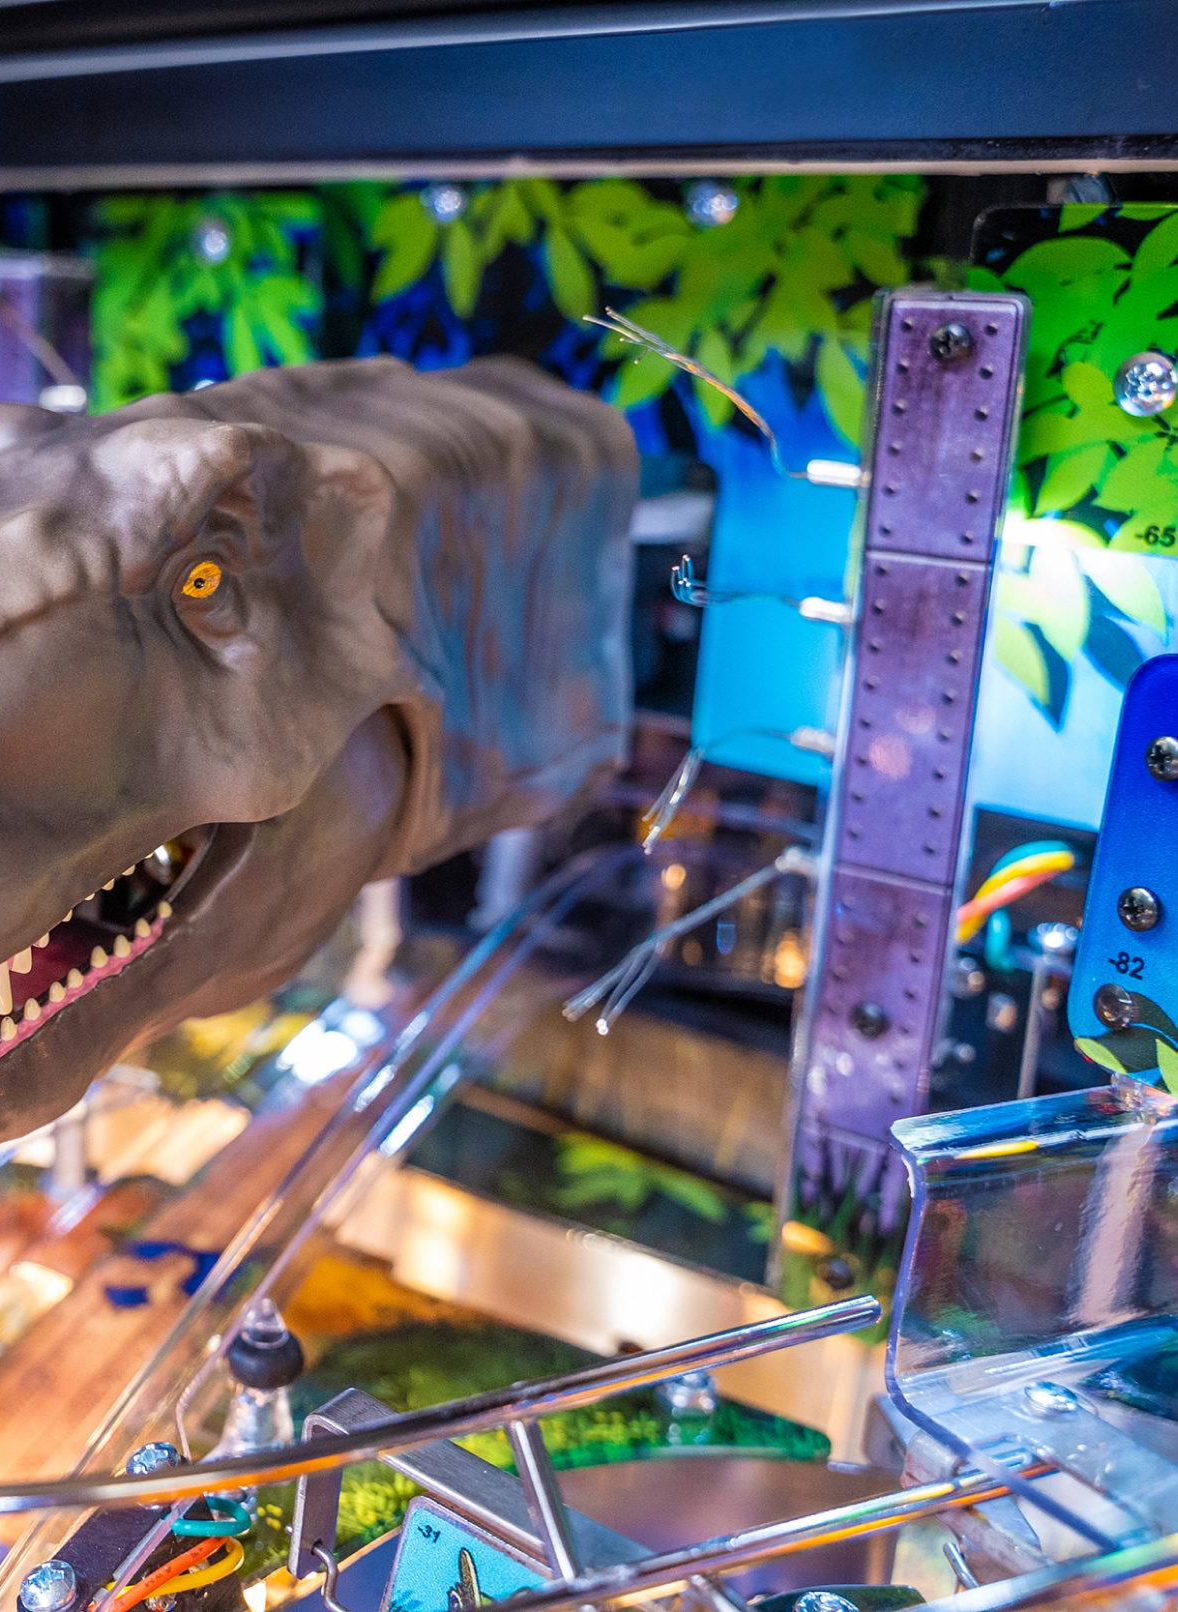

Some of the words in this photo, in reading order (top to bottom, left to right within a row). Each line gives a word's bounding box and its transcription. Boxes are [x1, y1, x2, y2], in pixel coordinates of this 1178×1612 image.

[1134, 525, 1176, 547] -65
[1108, 951, 1144, 980] -82
[418, 1524, 441, 1543] -31
